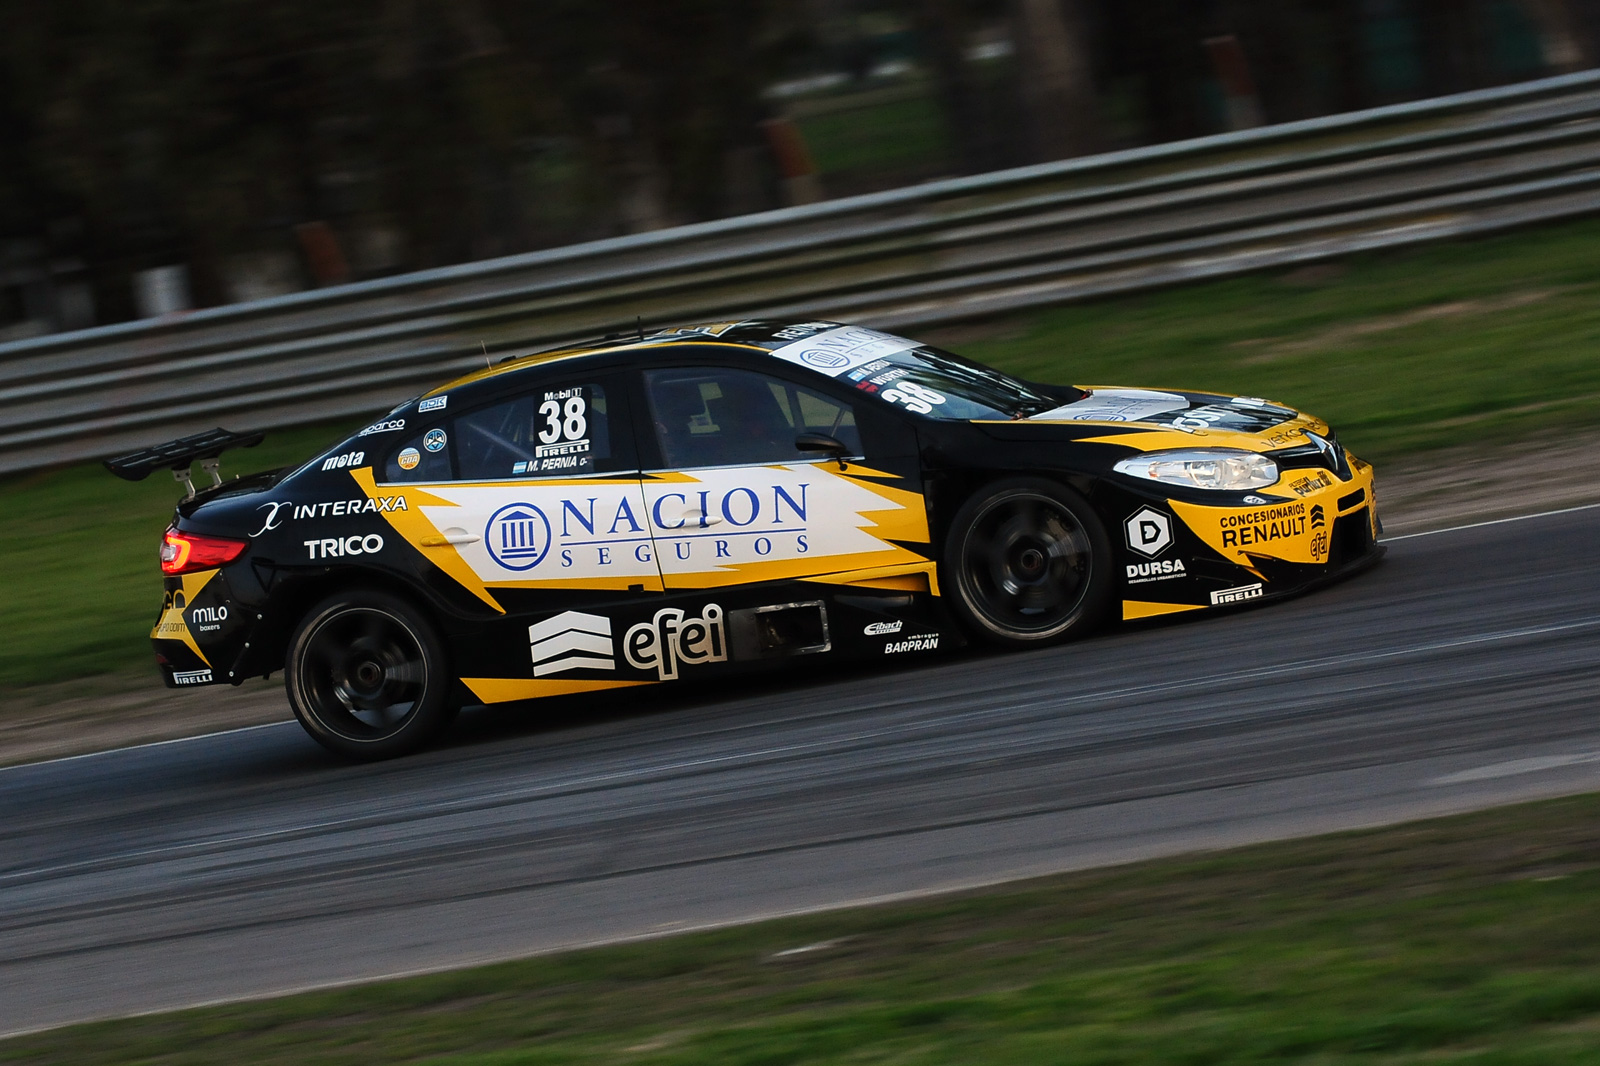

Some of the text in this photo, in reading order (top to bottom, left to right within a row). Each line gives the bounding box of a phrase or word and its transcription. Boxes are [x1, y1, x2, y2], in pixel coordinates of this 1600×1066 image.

[544, 389, 571, 401] Mobil
[881, 381, 946, 415] 38
[358, 418, 405, 437] sparco
[538, 396, 587, 444] 38
[535, 439, 590, 458] PIRELLI
[322, 451, 365, 471] mota
[527, 460, 539, 472] M.
[541, 456, 577, 471] PERNIA
[293, 496, 408, 520] INTERAXA
[560, 483, 810, 538] NACION
[1220, 503, 1305, 528] CONCESIONARIOS
[1222, 516, 1306, 548] RENAULT
[304, 534, 384, 559] TRICO
[561, 535, 809, 567] SEGUROS
[1126, 559, 1186, 578] DURSA
[1210, 583, 1263, 605] PIRELLI
[623, 603, 728, 681] efei
[884, 638, 939, 654] BARPRAN
[173, 669, 213, 685] PIRELLI
